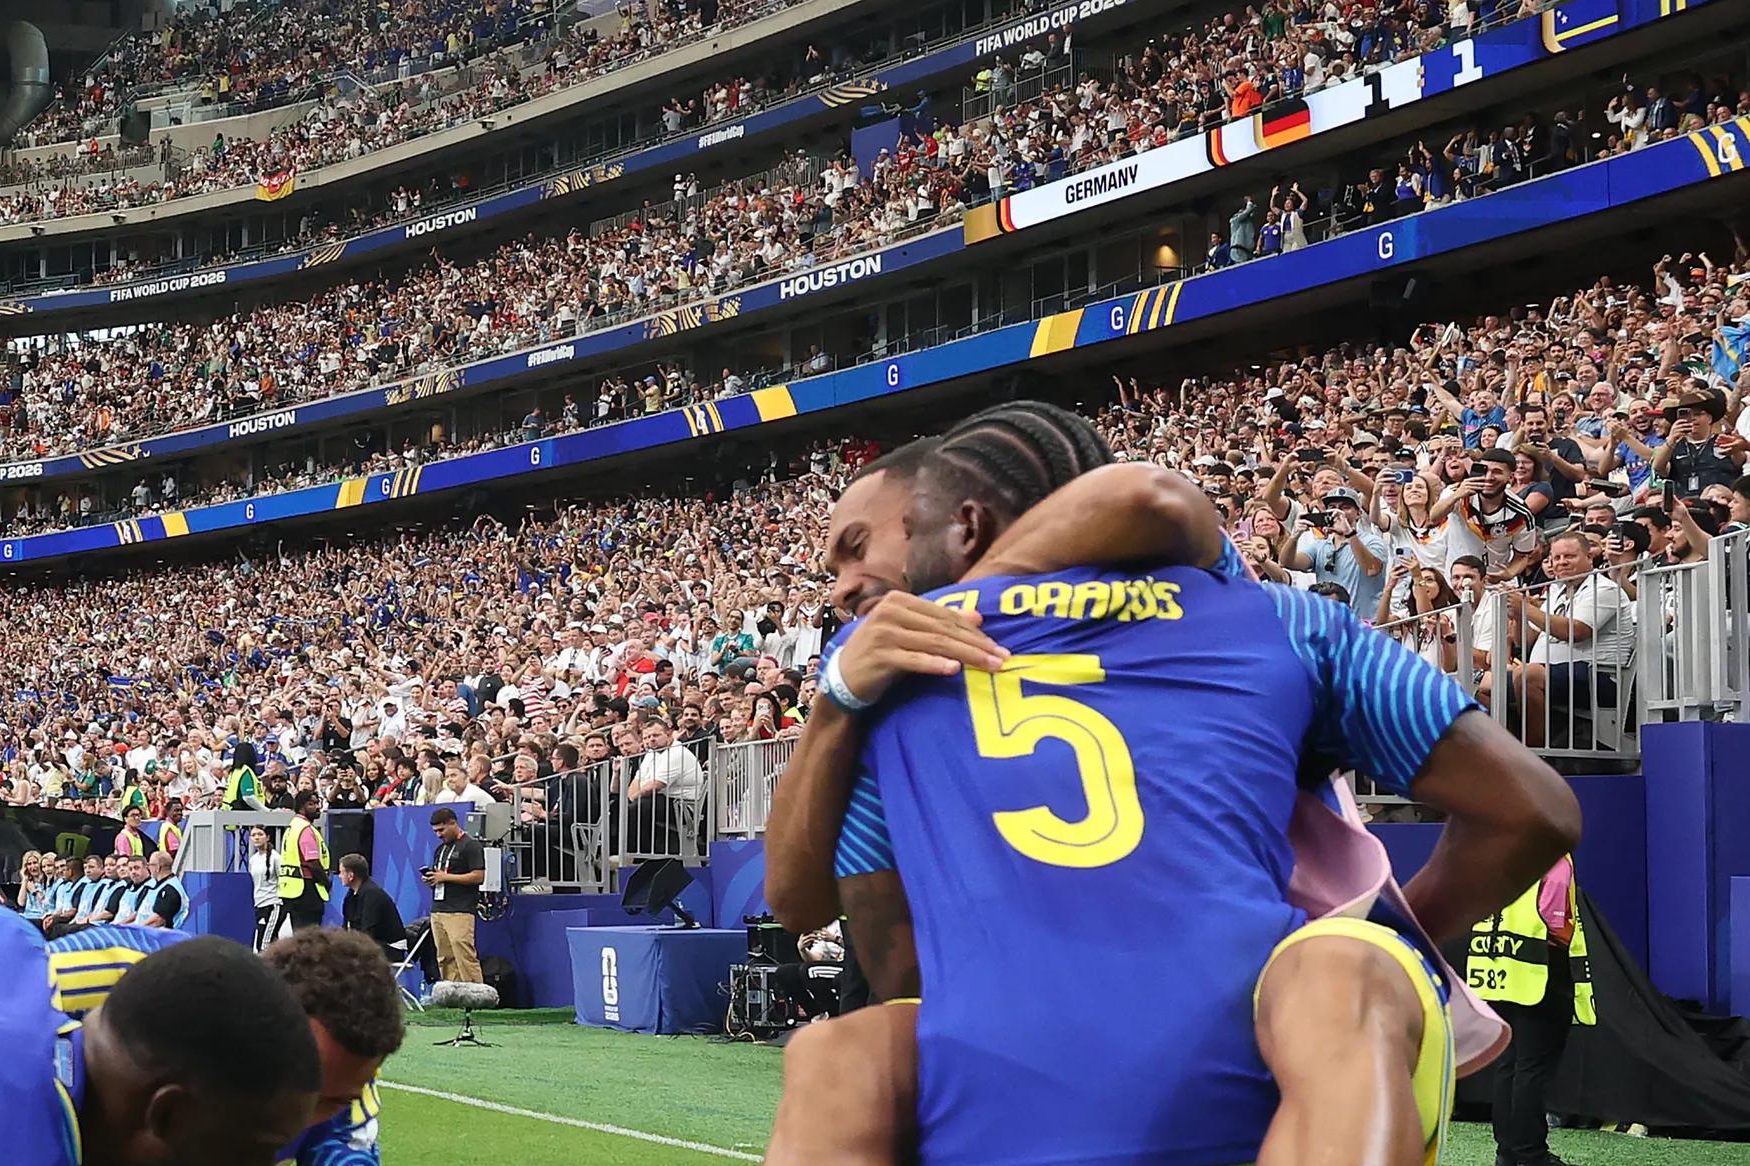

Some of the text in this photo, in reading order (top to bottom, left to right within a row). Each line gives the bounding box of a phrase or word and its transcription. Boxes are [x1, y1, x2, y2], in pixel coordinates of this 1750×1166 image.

[976, 36, 1003, 57] FIFA
[1003, 15, 1050, 47] WORLD
[1051, 6, 1078, 29] CUP
[1364, 38, 1483, 110] 1 1
[1719, 133, 1736, 164] G
[1065, 164, 1138, 204] GERMANY
[405, 206, 477, 239] HOUSTON
[1379, 231, 1393, 259] G
[110, 271, 226, 302] FIFA WORLD CUP 2026
[779, 253, 882, 300] HOUSTON
[1111, 307, 1124, 331] G
[887, 364, 899, 386] G
[229, 410, 296, 439] HOUSTON
[531, 447, 540, 464] G
[7, 463, 43, 479] 2026
[382, 478, 390, 495] G
[246, 503, 254, 519] G
[4, 544, 12, 558] G
[963, 653, 1146, 869] 5
